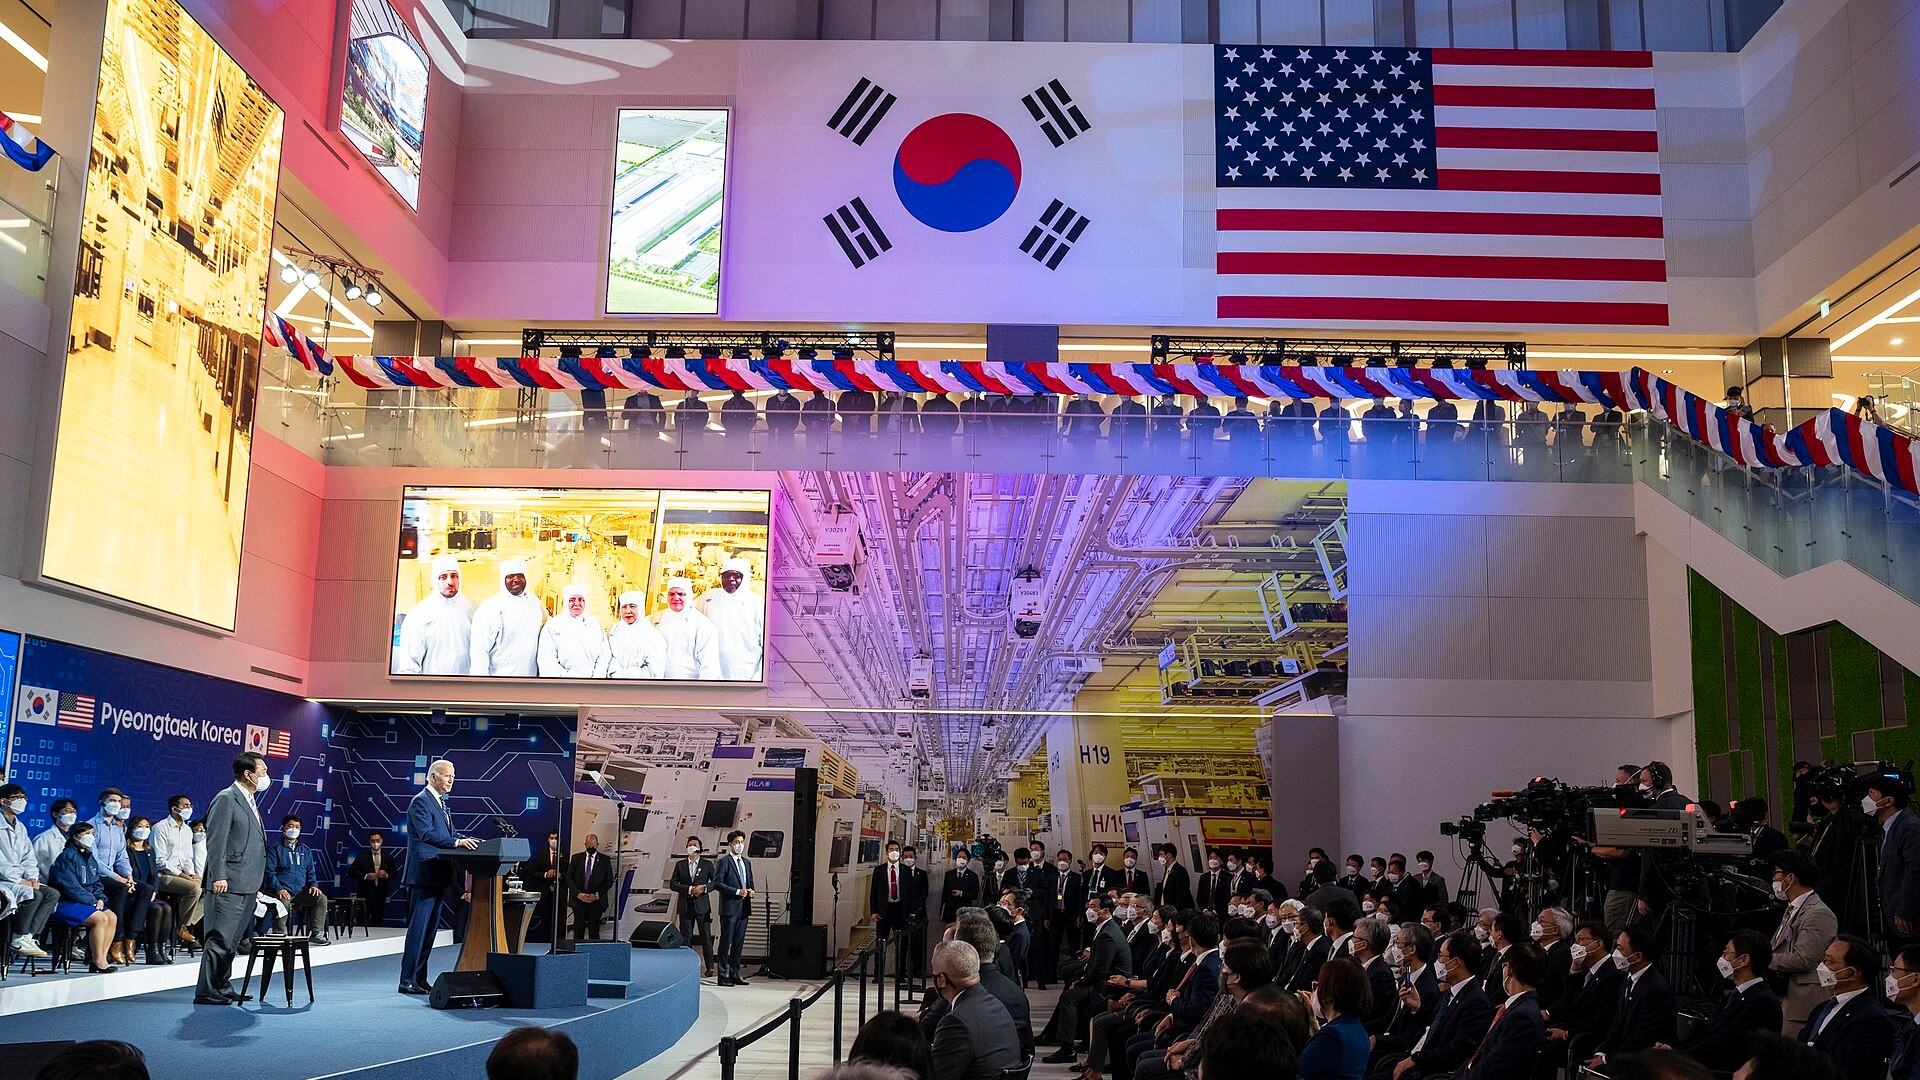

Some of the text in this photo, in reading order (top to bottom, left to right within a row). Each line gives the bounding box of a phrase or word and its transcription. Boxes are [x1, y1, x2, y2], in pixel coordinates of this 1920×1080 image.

[100, 701, 242, 746] Pyeongtaek Korea
[1079, 744, 1111, 765] H19
[1021, 797, 1037, 809] H20
